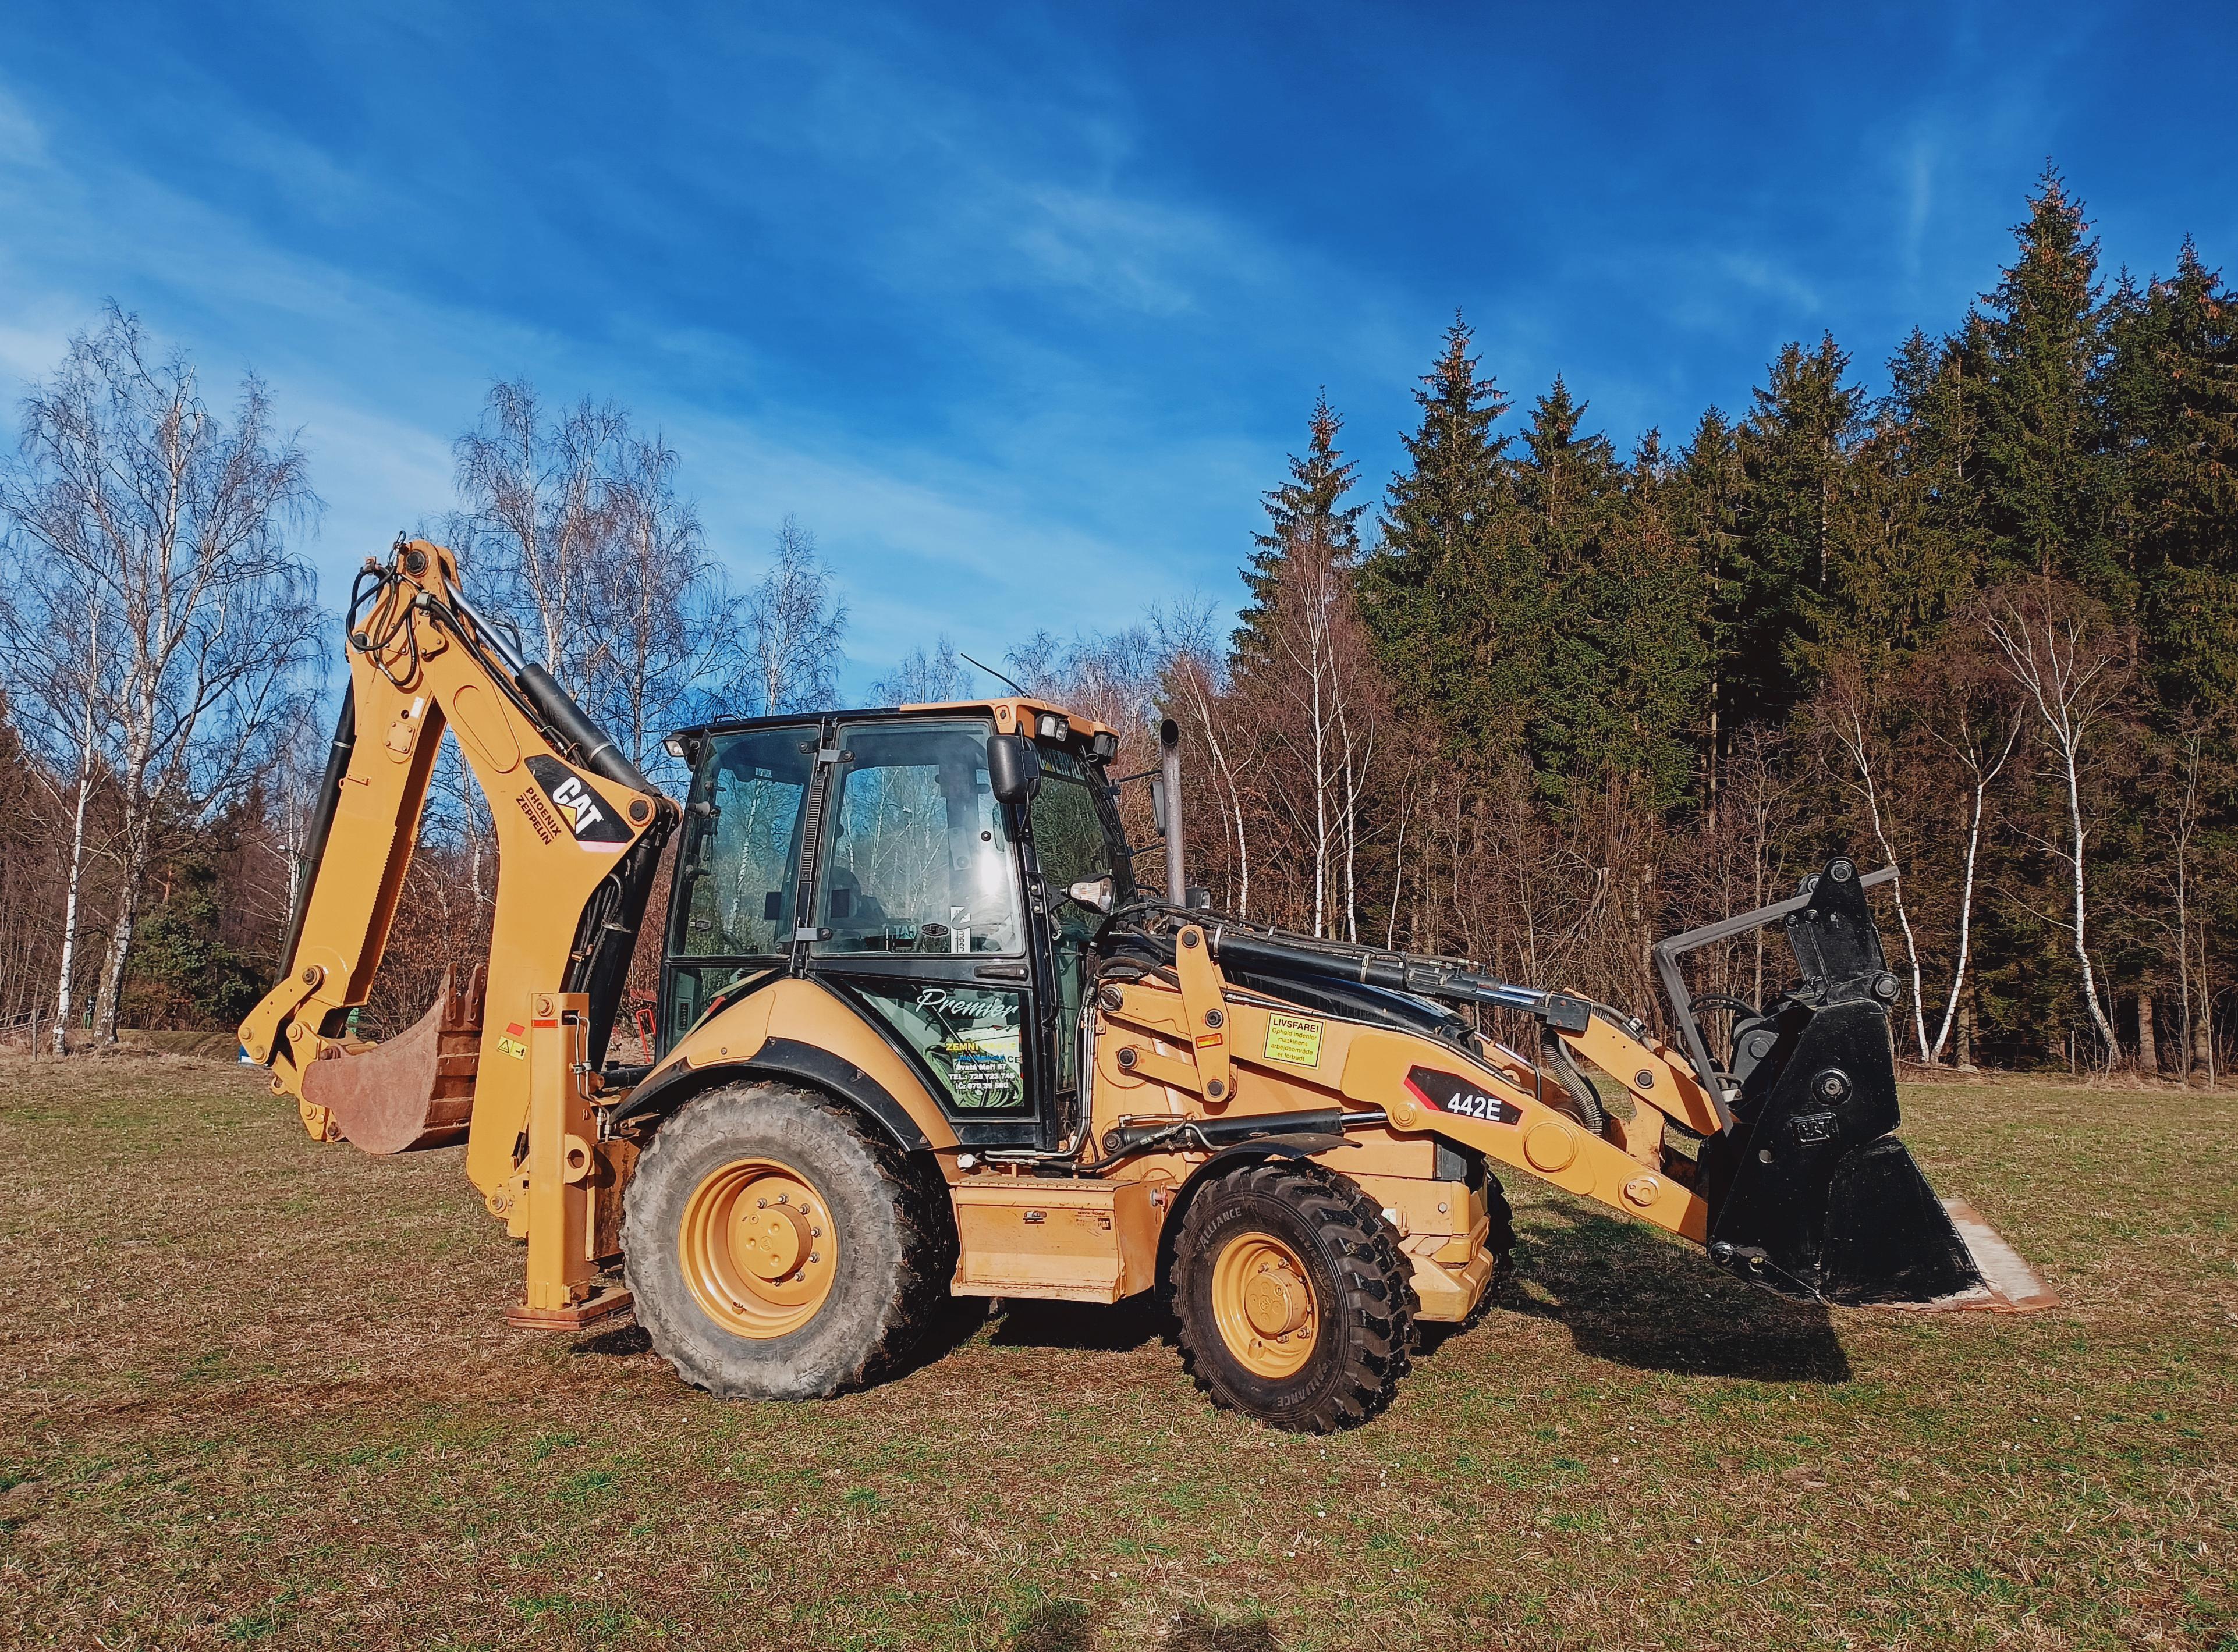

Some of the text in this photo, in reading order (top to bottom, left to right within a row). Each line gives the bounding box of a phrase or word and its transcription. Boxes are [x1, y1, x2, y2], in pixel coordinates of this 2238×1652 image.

[516, 795, 552, 845] ZEPPELIN
[526, 787, 562, 836] PHOENIX
[552, 777, 603, 834] CAT
[916, 989, 1019, 1018] Premier
[1272, 1028, 1317, 1040] Ophold indenfor
[1273, 1018, 1319, 1032] LIVSFARE!
[1271, 1043, 1313, 1055] arbejdsområde
[1278, 1037, 1308, 1046] maskinens
[1284, 1053, 1305, 1061] forbudt
[1448, 1092, 1502, 1121] 442E
[1199, 1206, 1242, 1251] ALLIANCE
